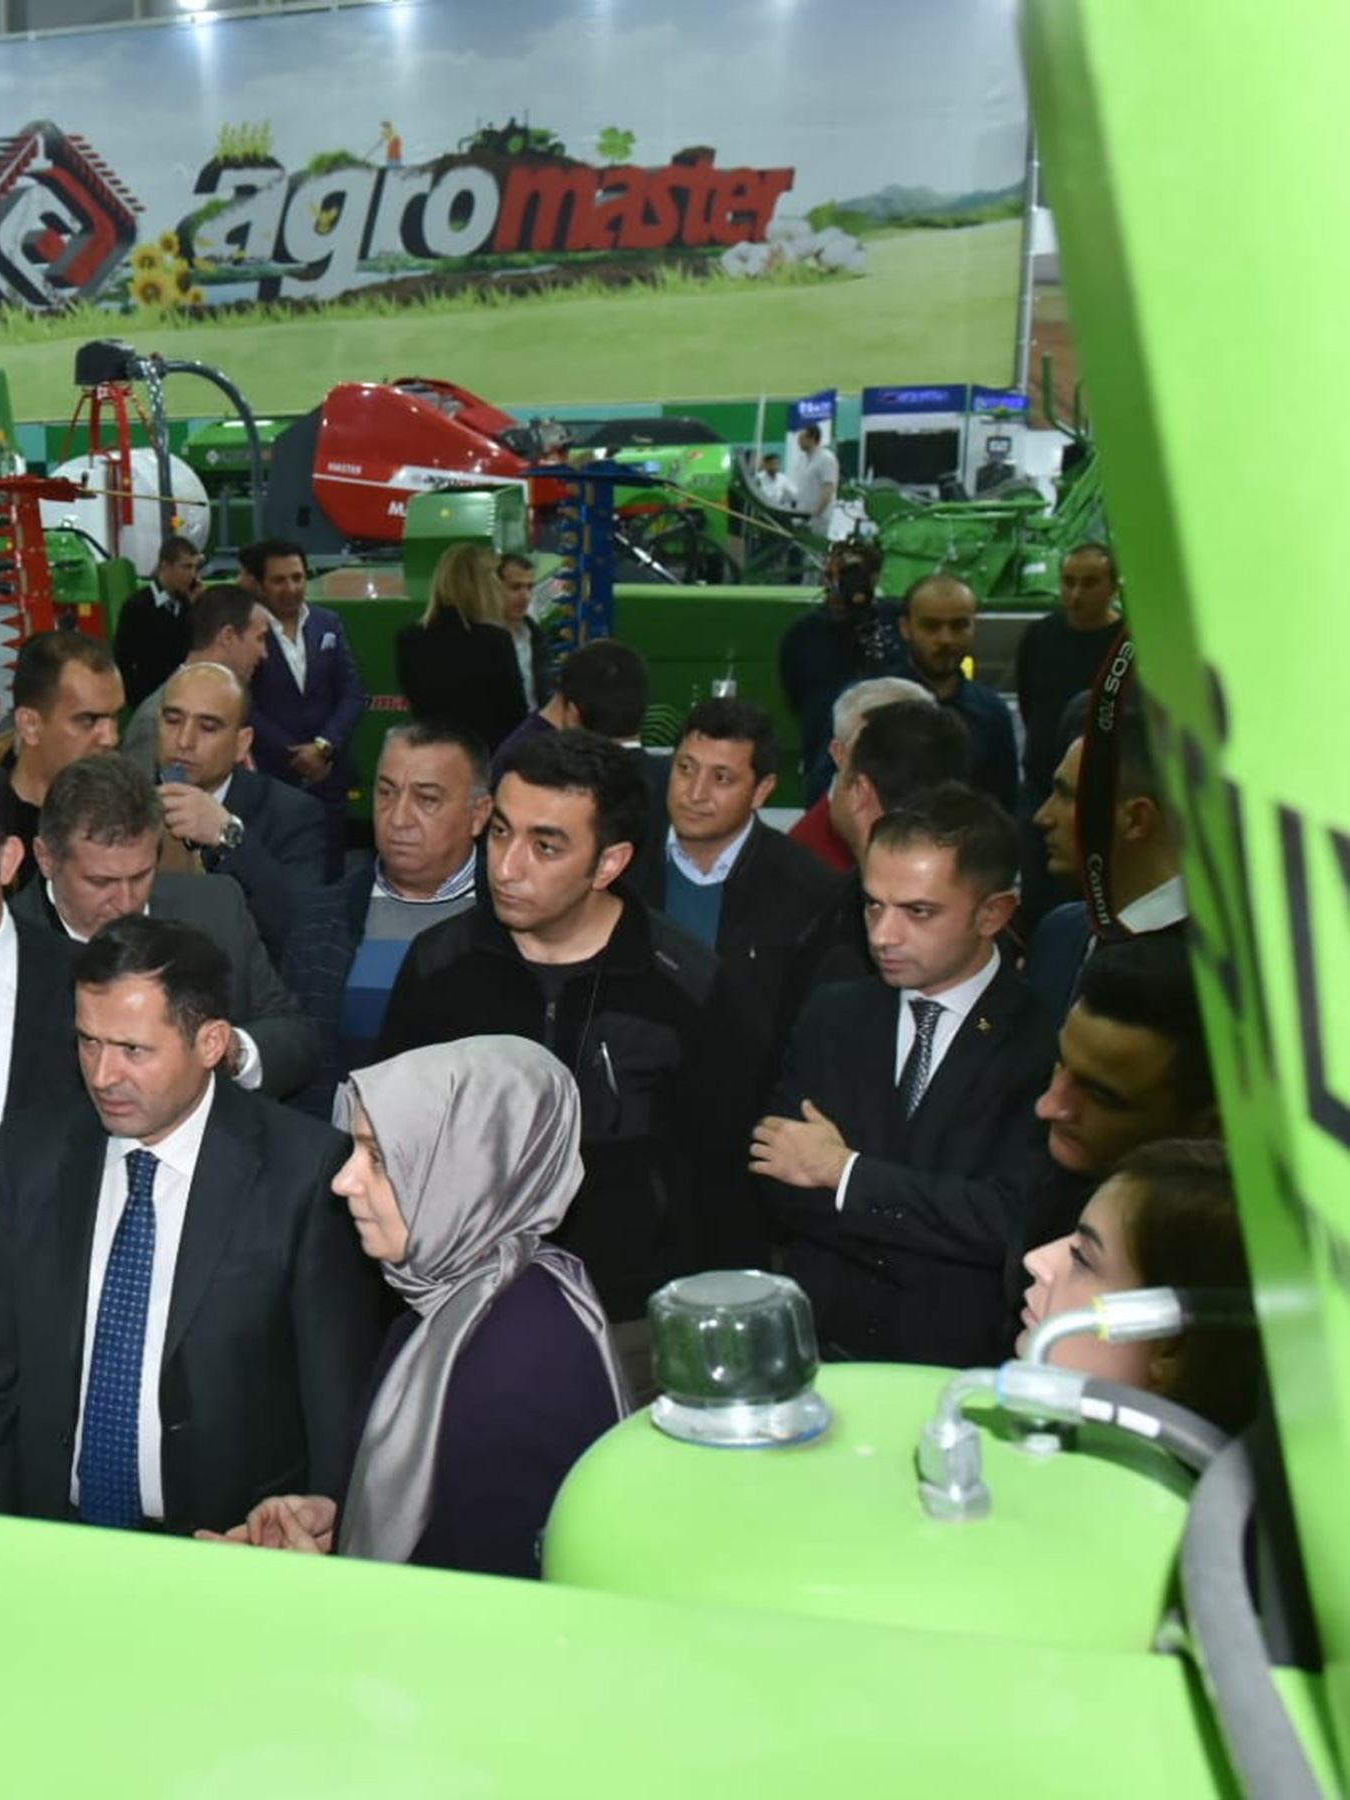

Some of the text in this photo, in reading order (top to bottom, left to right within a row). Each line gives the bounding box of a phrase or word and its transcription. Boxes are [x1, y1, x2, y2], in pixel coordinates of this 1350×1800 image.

[177, 147, 796, 302] agromaster
[1104, 641, 1135, 695] EOS
[1087, 853, 1111, 925] Canon
